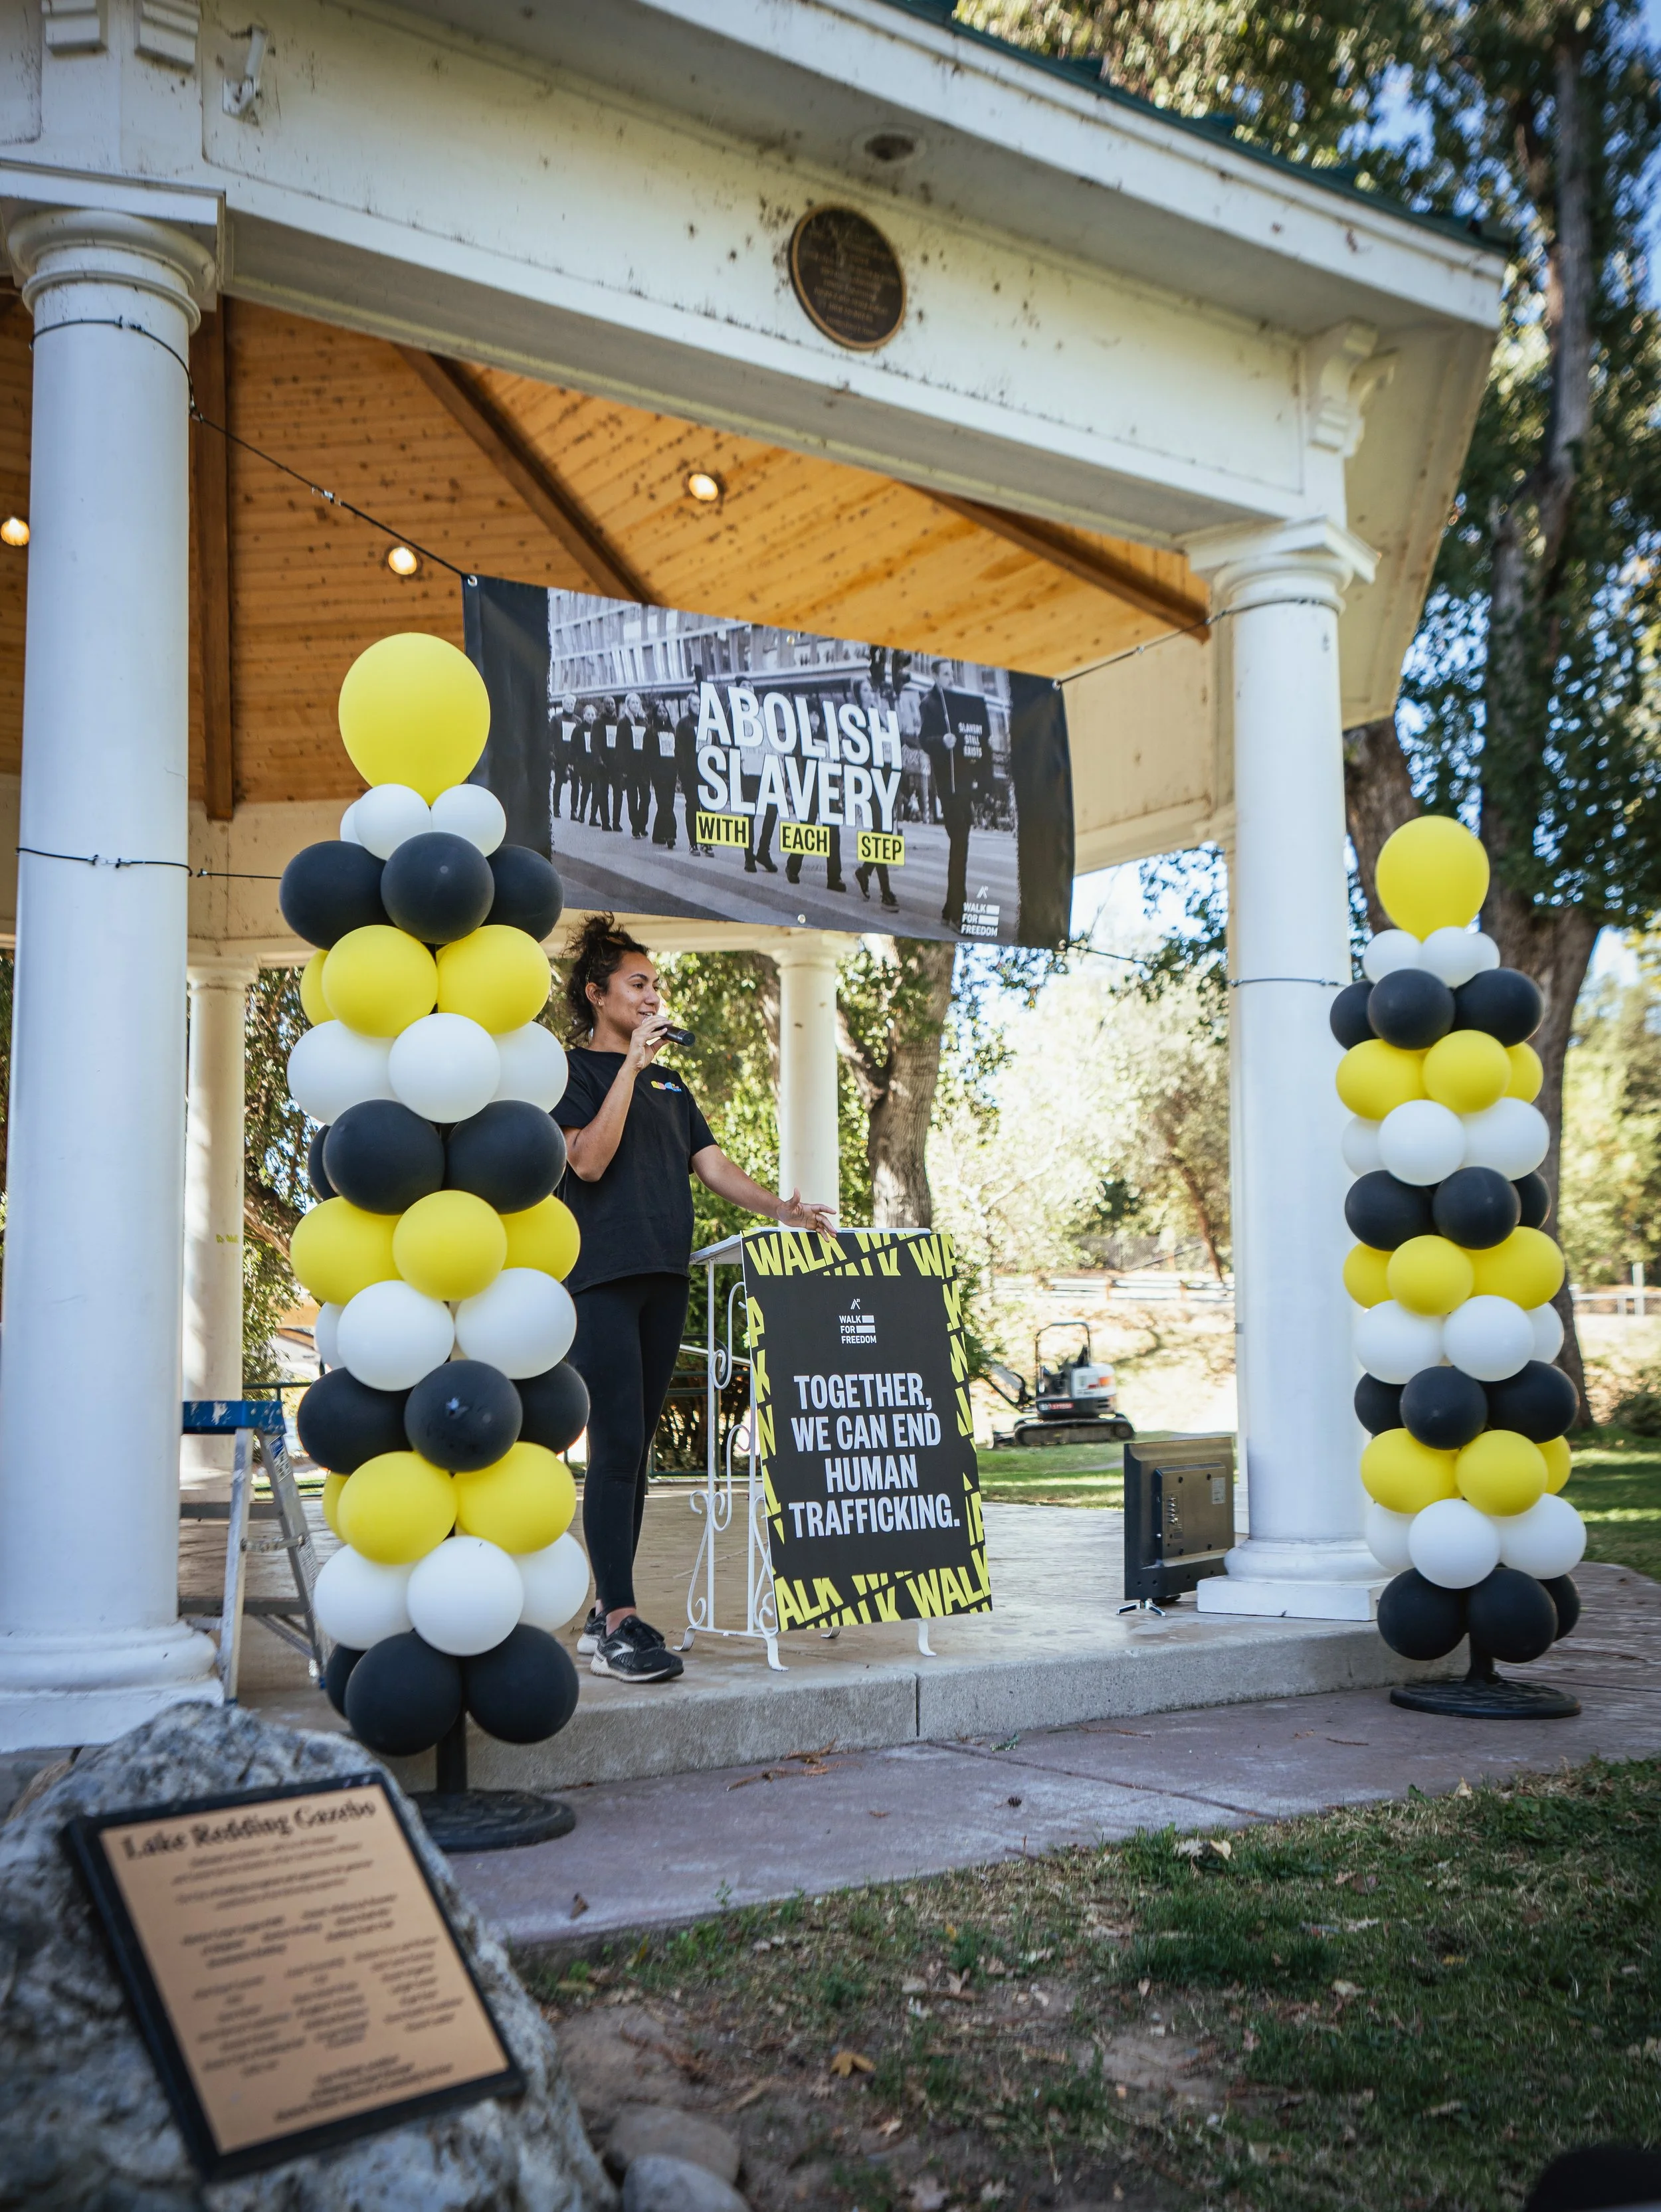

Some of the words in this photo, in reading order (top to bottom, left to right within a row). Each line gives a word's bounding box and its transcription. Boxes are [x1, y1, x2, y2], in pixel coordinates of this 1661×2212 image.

[696, 682, 903, 771] ABOLISH
[958, 722, 983, 736] SLAVERY
[964, 734, 980, 747] STILL
[697, 745, 902, 832] SLAVERY
[698, 815, 747, 844] WITH
[782, 826, 829, 854] EACH
[861, 835, 902, 862] STEP
[962, 913, 978, 924] FOR
[963, 902, 987, 913] WALK
[961, 924, 999, 937] FREEDOM
[839, 1315, 862, 1324] WALK
[840, 1325, 856, 1334] FOR
[841, 1335, 877, 1344] FREEDOM
[793, 1372, 933, 1411] TOGETHER,
[791, 1416, 831, 1453] WE
[836, 1414, 889, 1450] CAN
[894, 1412, 941, 1447] END
[825, 1454, 918, 1493] HUMAN
[789, 1493, 961, 1538] TRAFFICKING.
[121, 1829, 189, 1861] Lake
[190, 1813, 292, 1849] Redding
